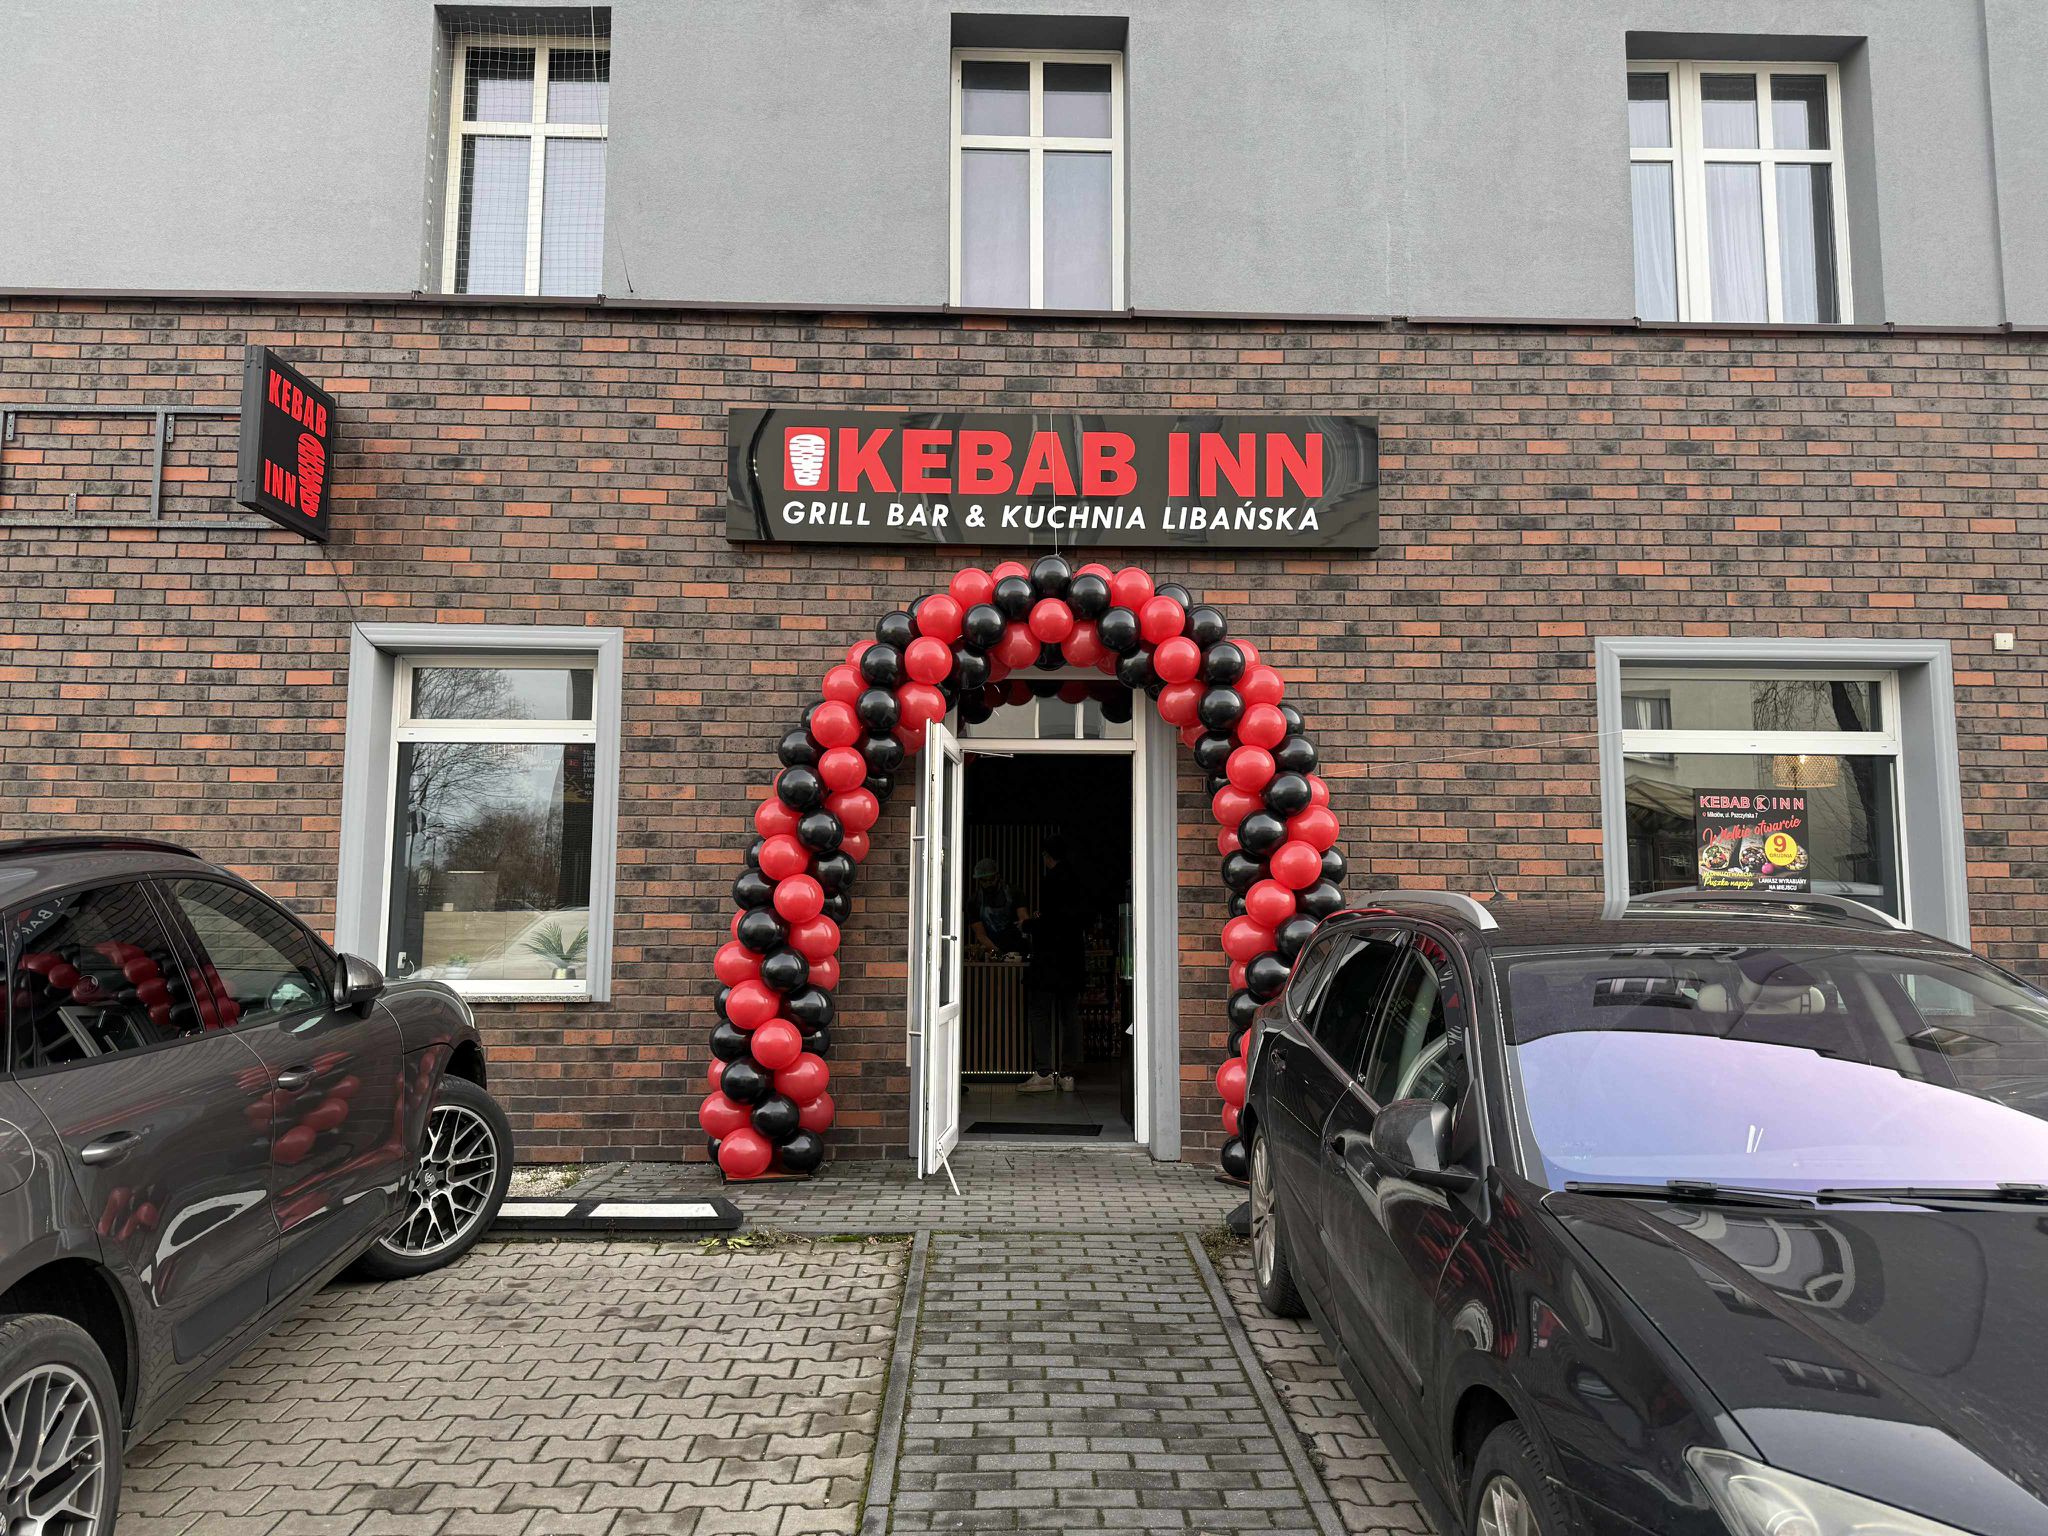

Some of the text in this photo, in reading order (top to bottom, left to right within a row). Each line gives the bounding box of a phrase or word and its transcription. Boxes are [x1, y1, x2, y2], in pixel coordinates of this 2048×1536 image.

[268, 368, 327, 438] KEBAB
[837, 427, 1324, 498] KEBAB INN
[264, 458, 297, 508] INN
[782, 501, 1319, 531] GRILL BAR & KUCHNIA LIBAŃSKA
[1700, 795, 1751, 809] KEBAB
[1772, 797, 1804, 810] INN
[1754, 815, 1802, 835] otwarcie
[1773, 835, 1787, 853] 9
